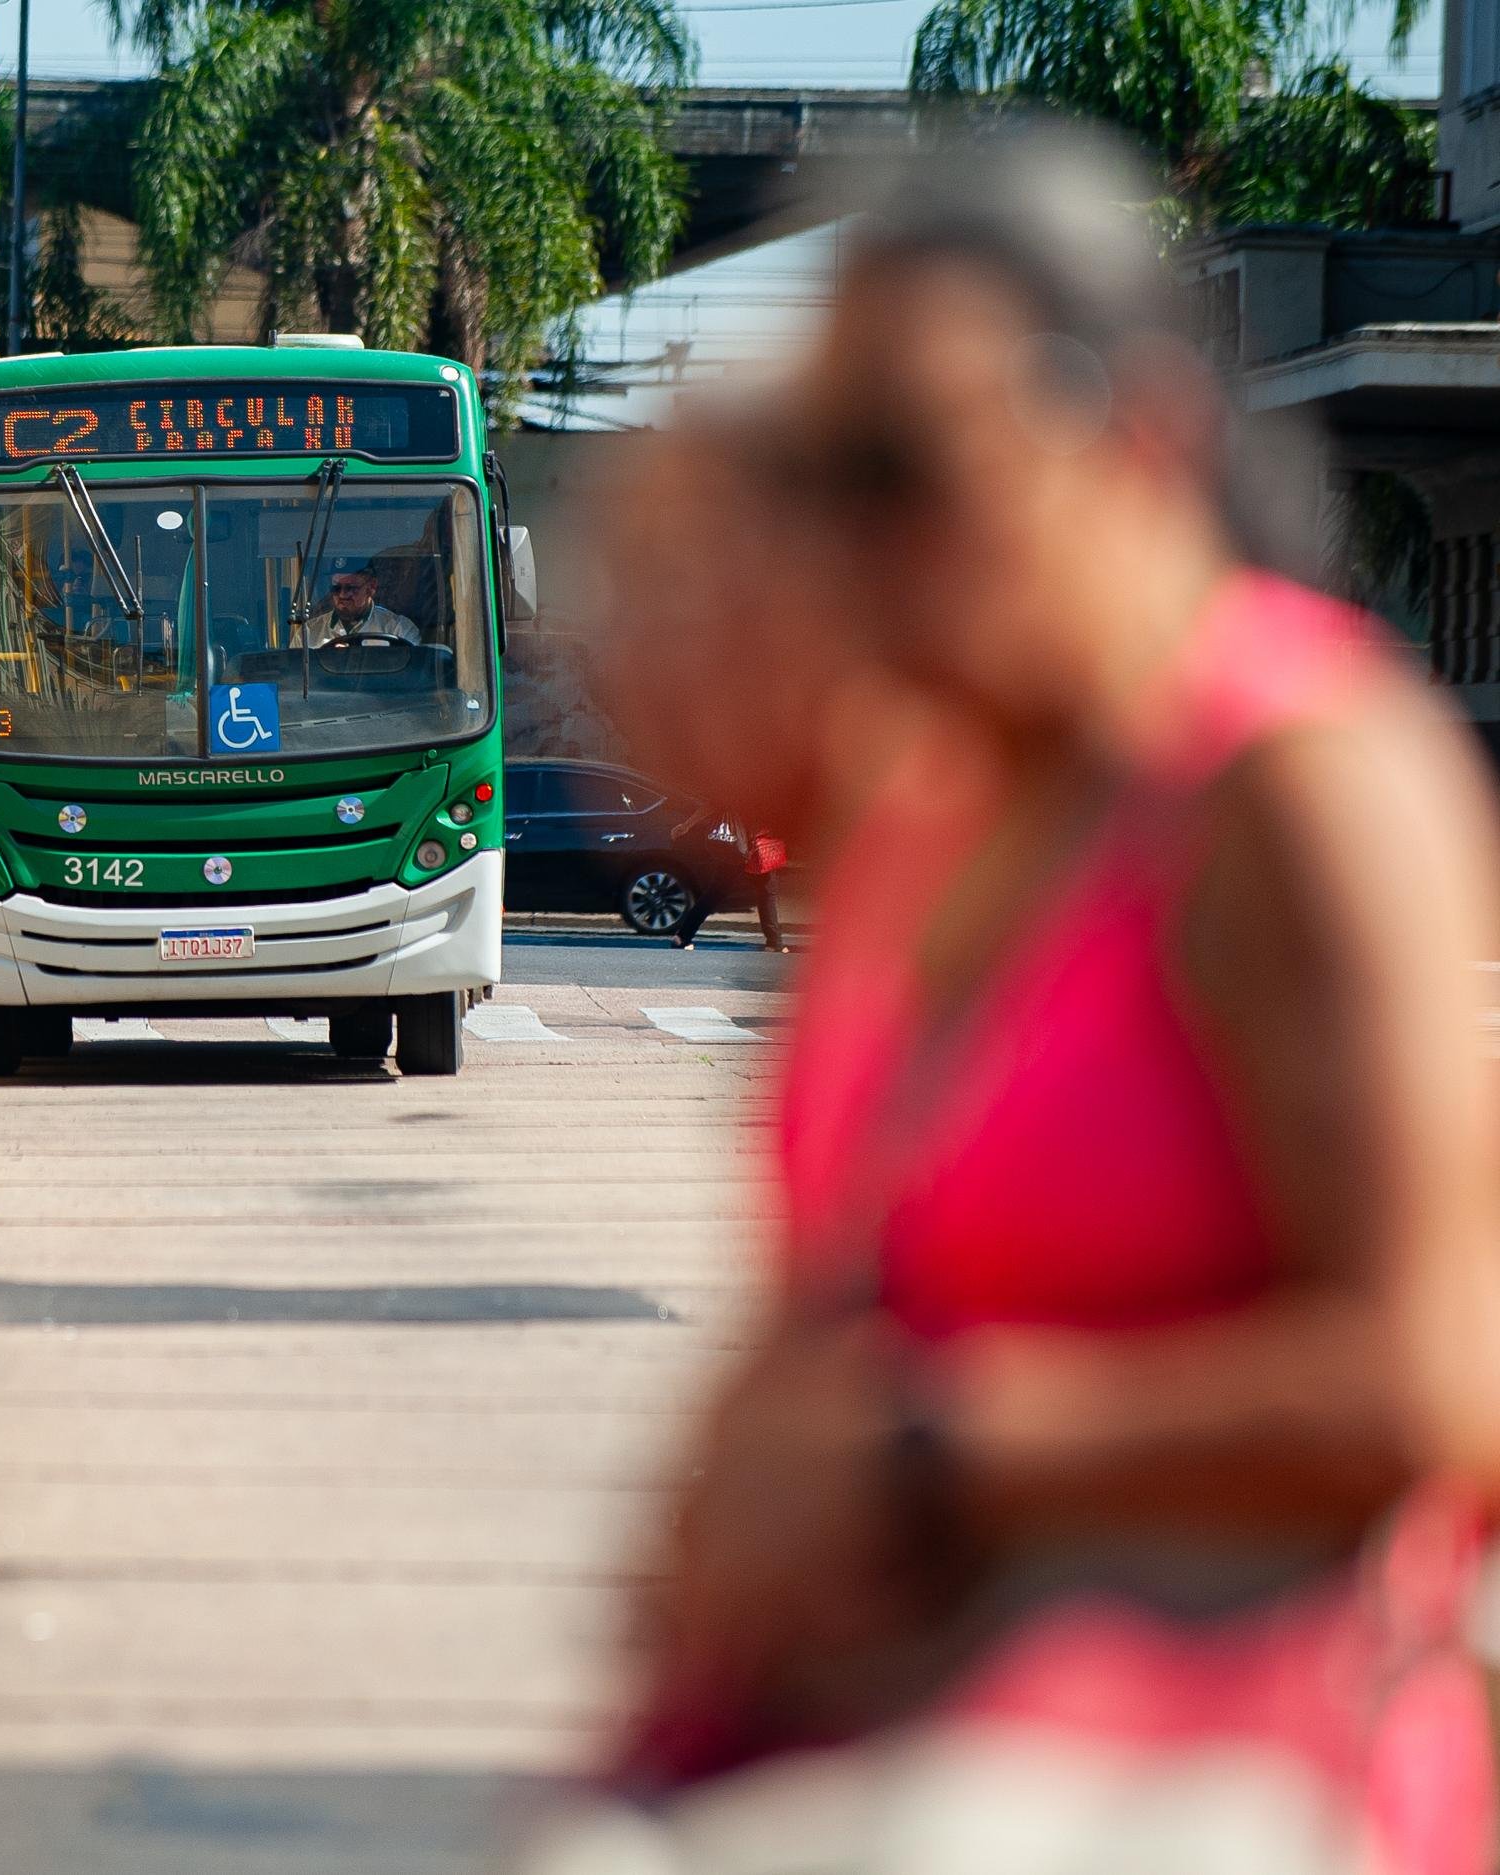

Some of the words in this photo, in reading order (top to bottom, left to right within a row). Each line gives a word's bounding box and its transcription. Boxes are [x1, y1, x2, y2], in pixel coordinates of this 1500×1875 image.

[4, 409, 99, 457] C2
[138, 769, 284, 786] MASCARELLO
[64, 857, 144, 887] 3142
[169, 939, 243, 956] ITQ1J37
